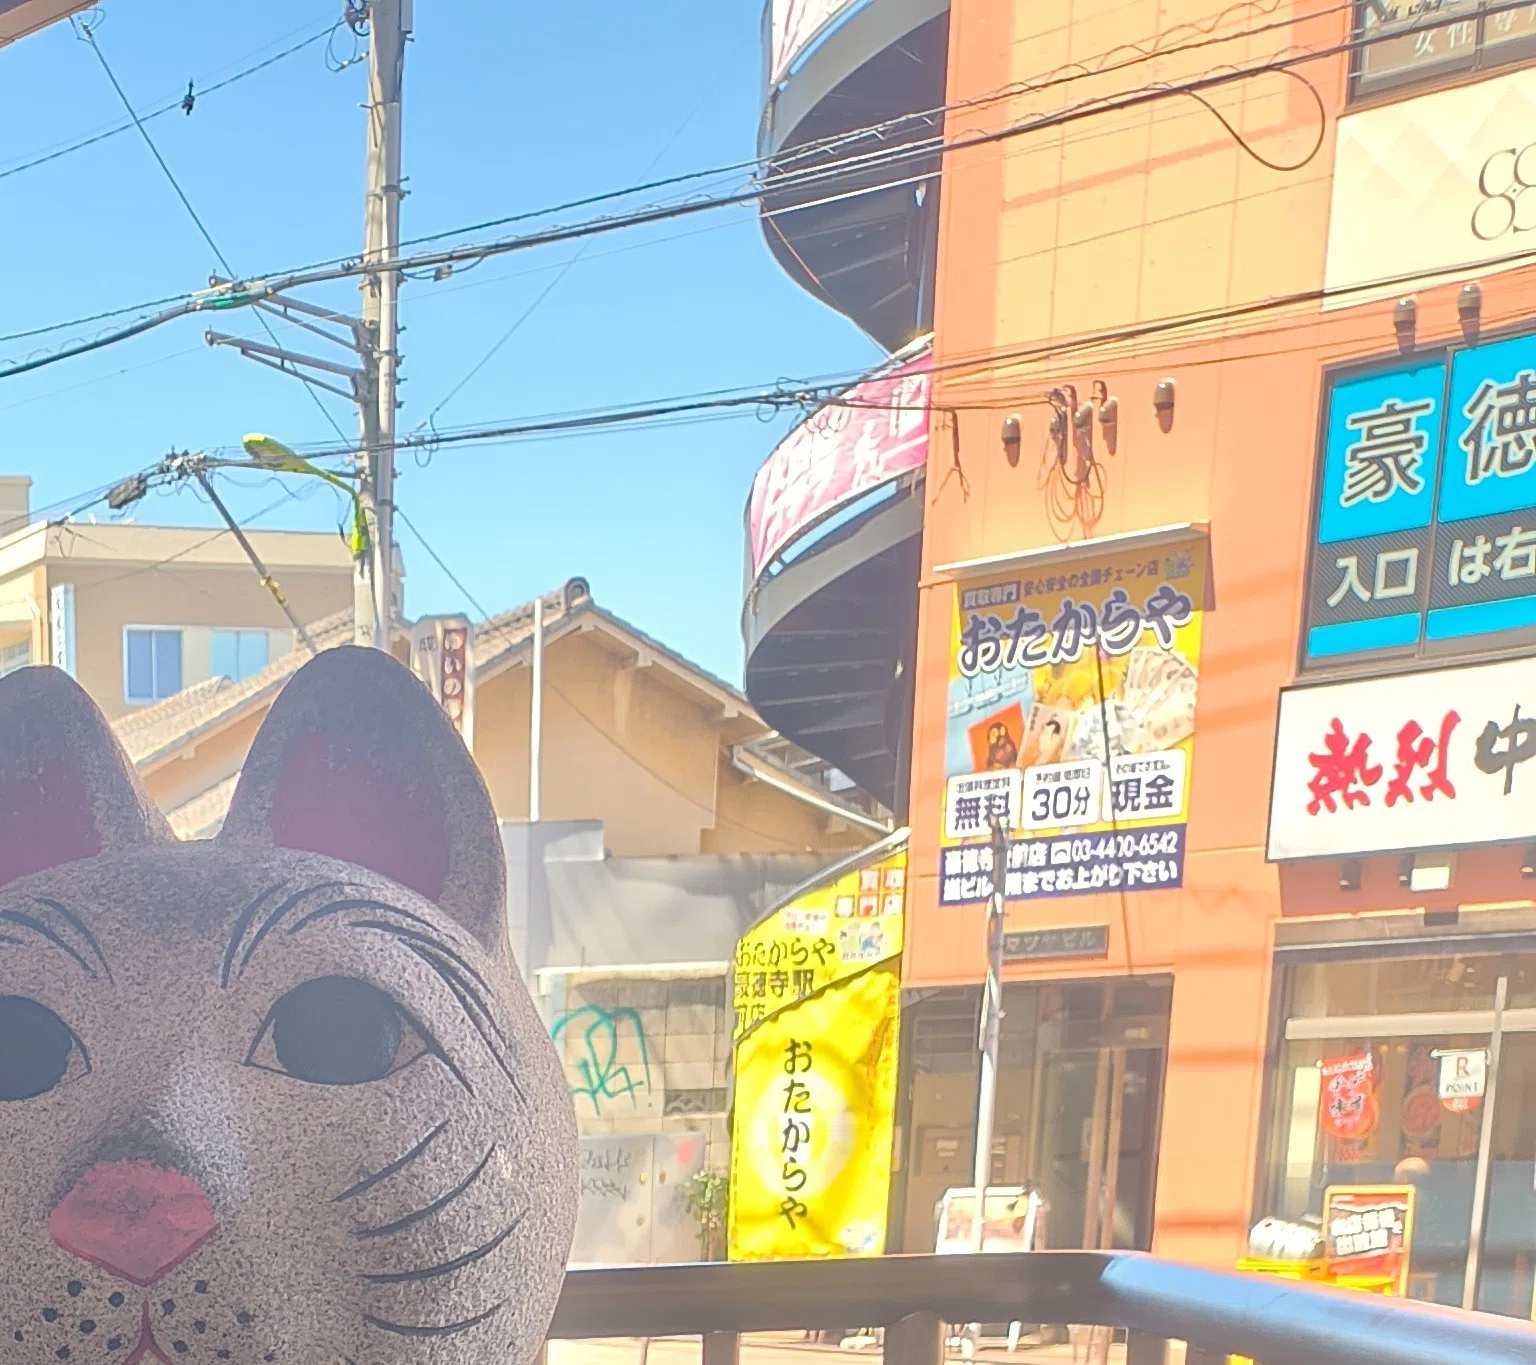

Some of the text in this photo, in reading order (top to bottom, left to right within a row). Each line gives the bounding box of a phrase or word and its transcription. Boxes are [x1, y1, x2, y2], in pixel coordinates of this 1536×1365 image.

[960, 585, 1192, 674] おたからや
[955, 792, 1011, 831] 無料
[1031, 785, 1091, 822] 30分
[1112, 774, 1175, 813] 現金
[736, 937, 836, 967] おたからや
[779, 1038, 813, 1230] おたからや
